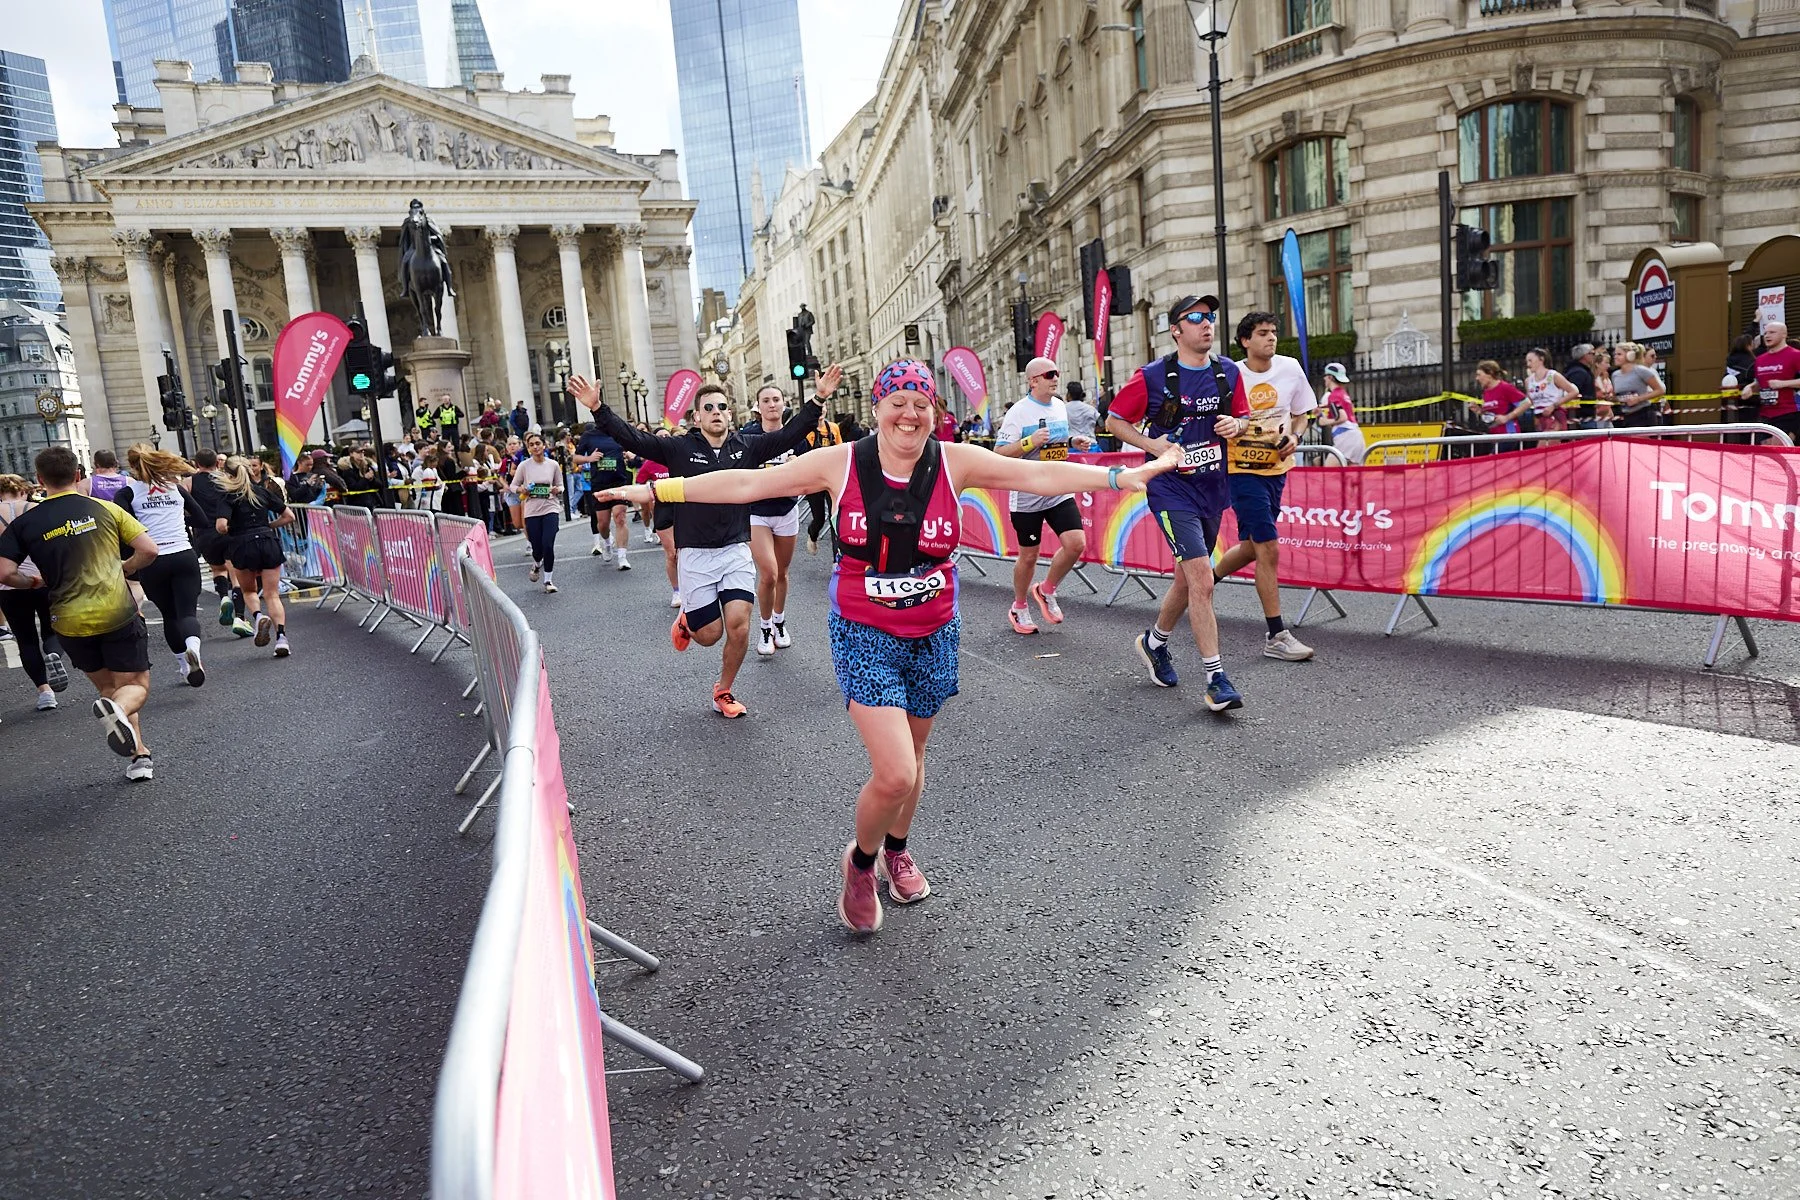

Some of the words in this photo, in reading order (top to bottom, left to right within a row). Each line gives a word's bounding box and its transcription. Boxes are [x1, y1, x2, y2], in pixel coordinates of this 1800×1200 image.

[136, 199, 173, 208] ANNO
[184, 198, 275, 208] ELIZABETHAE
[1636, 288, 1673, 307] UNDERGROUND
[1760, 294, 1784, 305] DRS
[1043, 324, 1056, 358] mmy's
[285, 329, 329, 400] Tommy's
[669, 377, 692, 411] Tommy's
[1046, 449, 1066, 460] 4290
[1184, 448, 1216, 465] 8693
[1241, 449, 1272, 461] 4927
[142, 500, 178, 509] EVERYTHING
[1277, 502, 1393, 535] mmy's
[43, 526, 66, 541] LONDON
[1305, 538, 1324, 548] and
[1326, 540, 1351, 551] baby
[1354, 542, 1392, 551] charity
[1649, 536, 1677, 549] The
[1682, 541, 1766, 560] pregnancy
